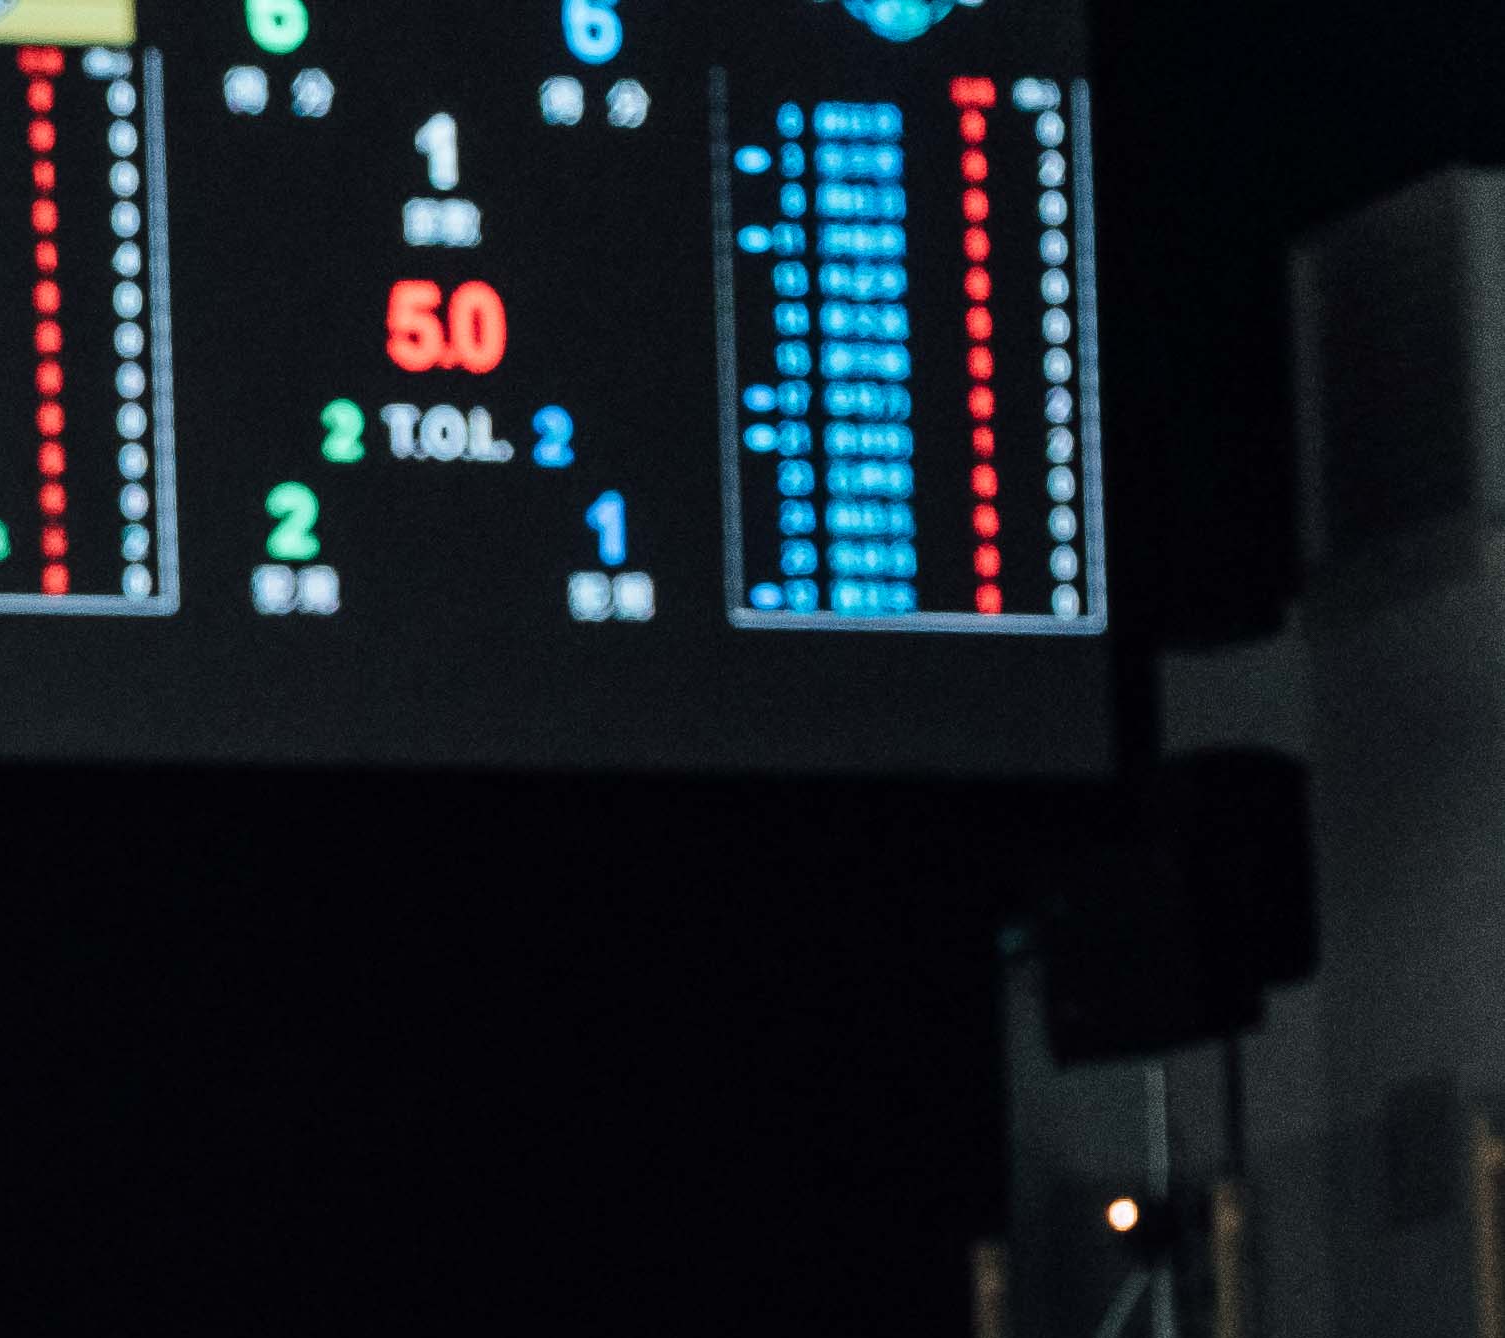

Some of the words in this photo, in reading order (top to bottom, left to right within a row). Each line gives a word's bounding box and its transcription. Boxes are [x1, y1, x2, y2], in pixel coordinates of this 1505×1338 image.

[415, 112, 460, 191] 1
[320, 398, 366, 463] 2
[531, 404, 575, 469] 2
[265, 481, 321, 562] 2
[586, 490, 627, 567] 1
